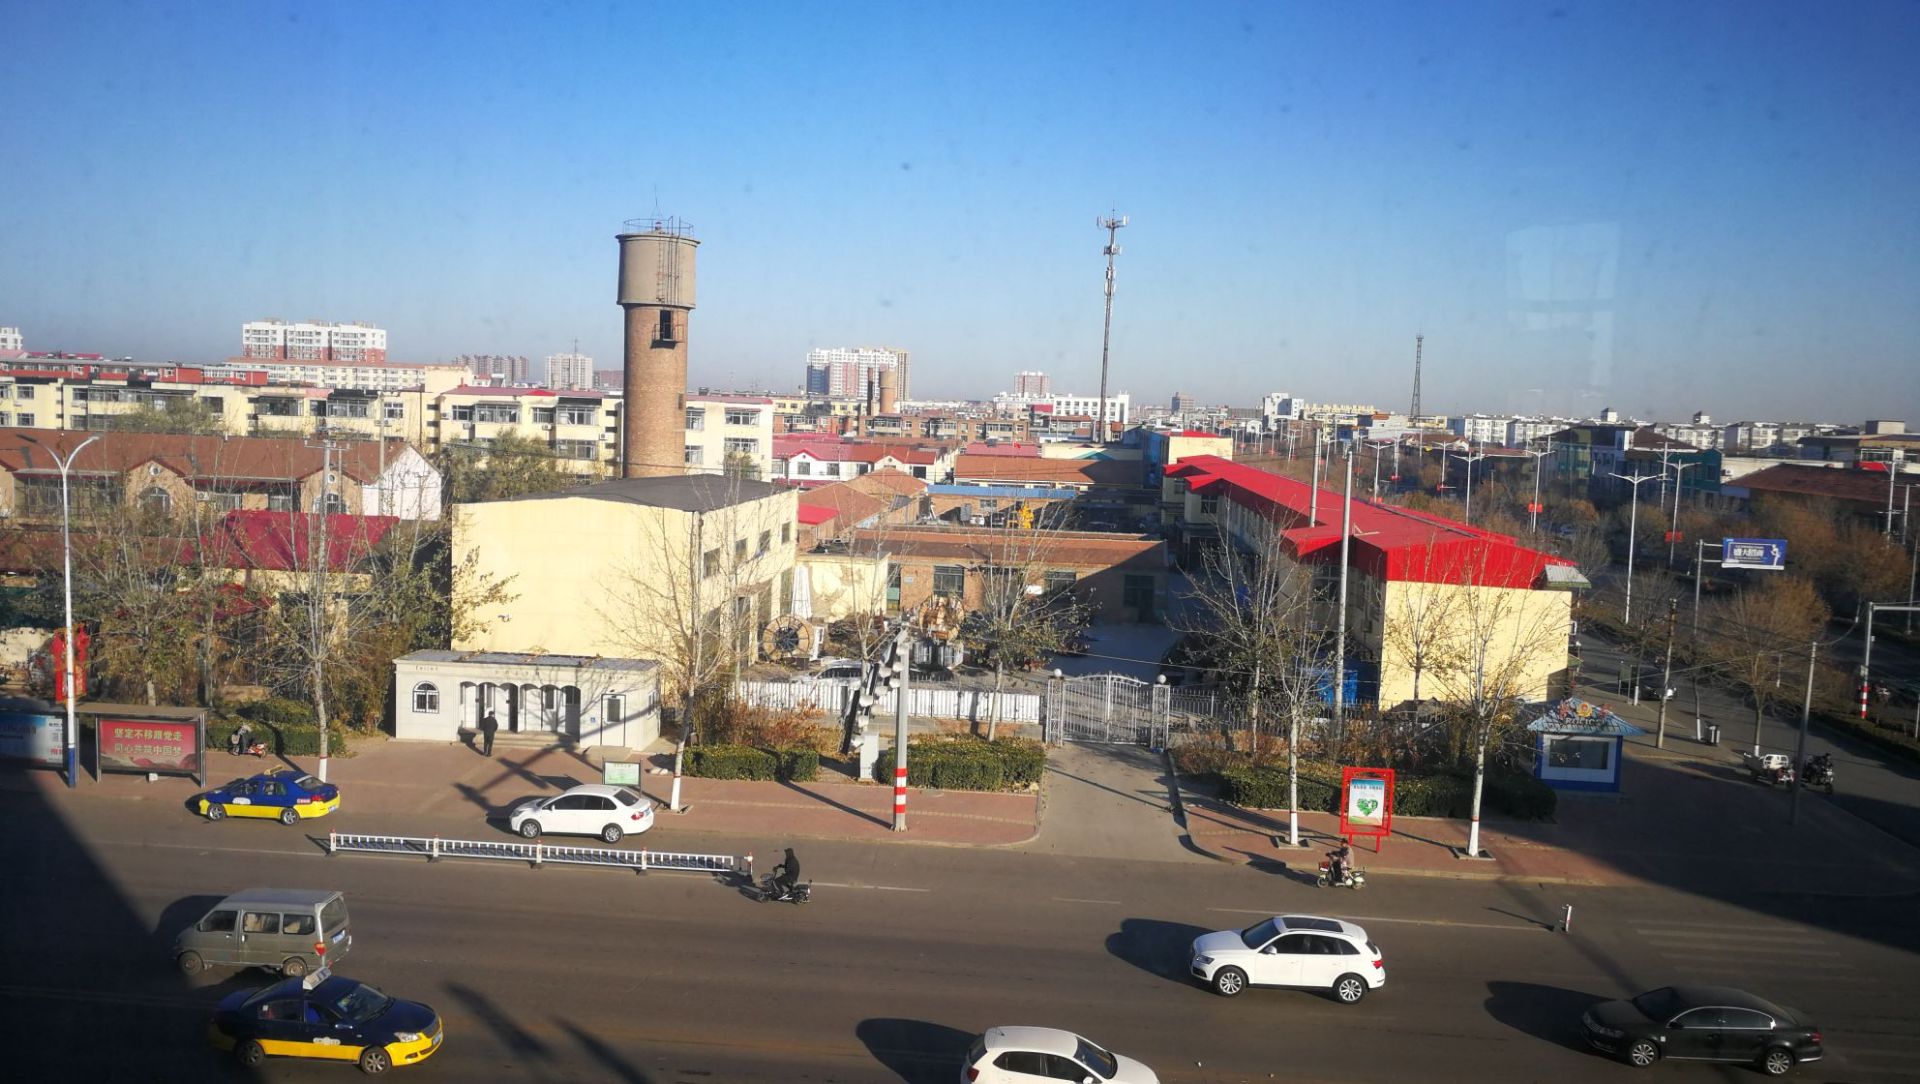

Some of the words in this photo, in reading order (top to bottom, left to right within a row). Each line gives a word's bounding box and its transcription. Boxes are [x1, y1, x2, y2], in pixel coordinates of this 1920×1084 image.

[114, 728, 182, 742] 坚定不移跟党走
